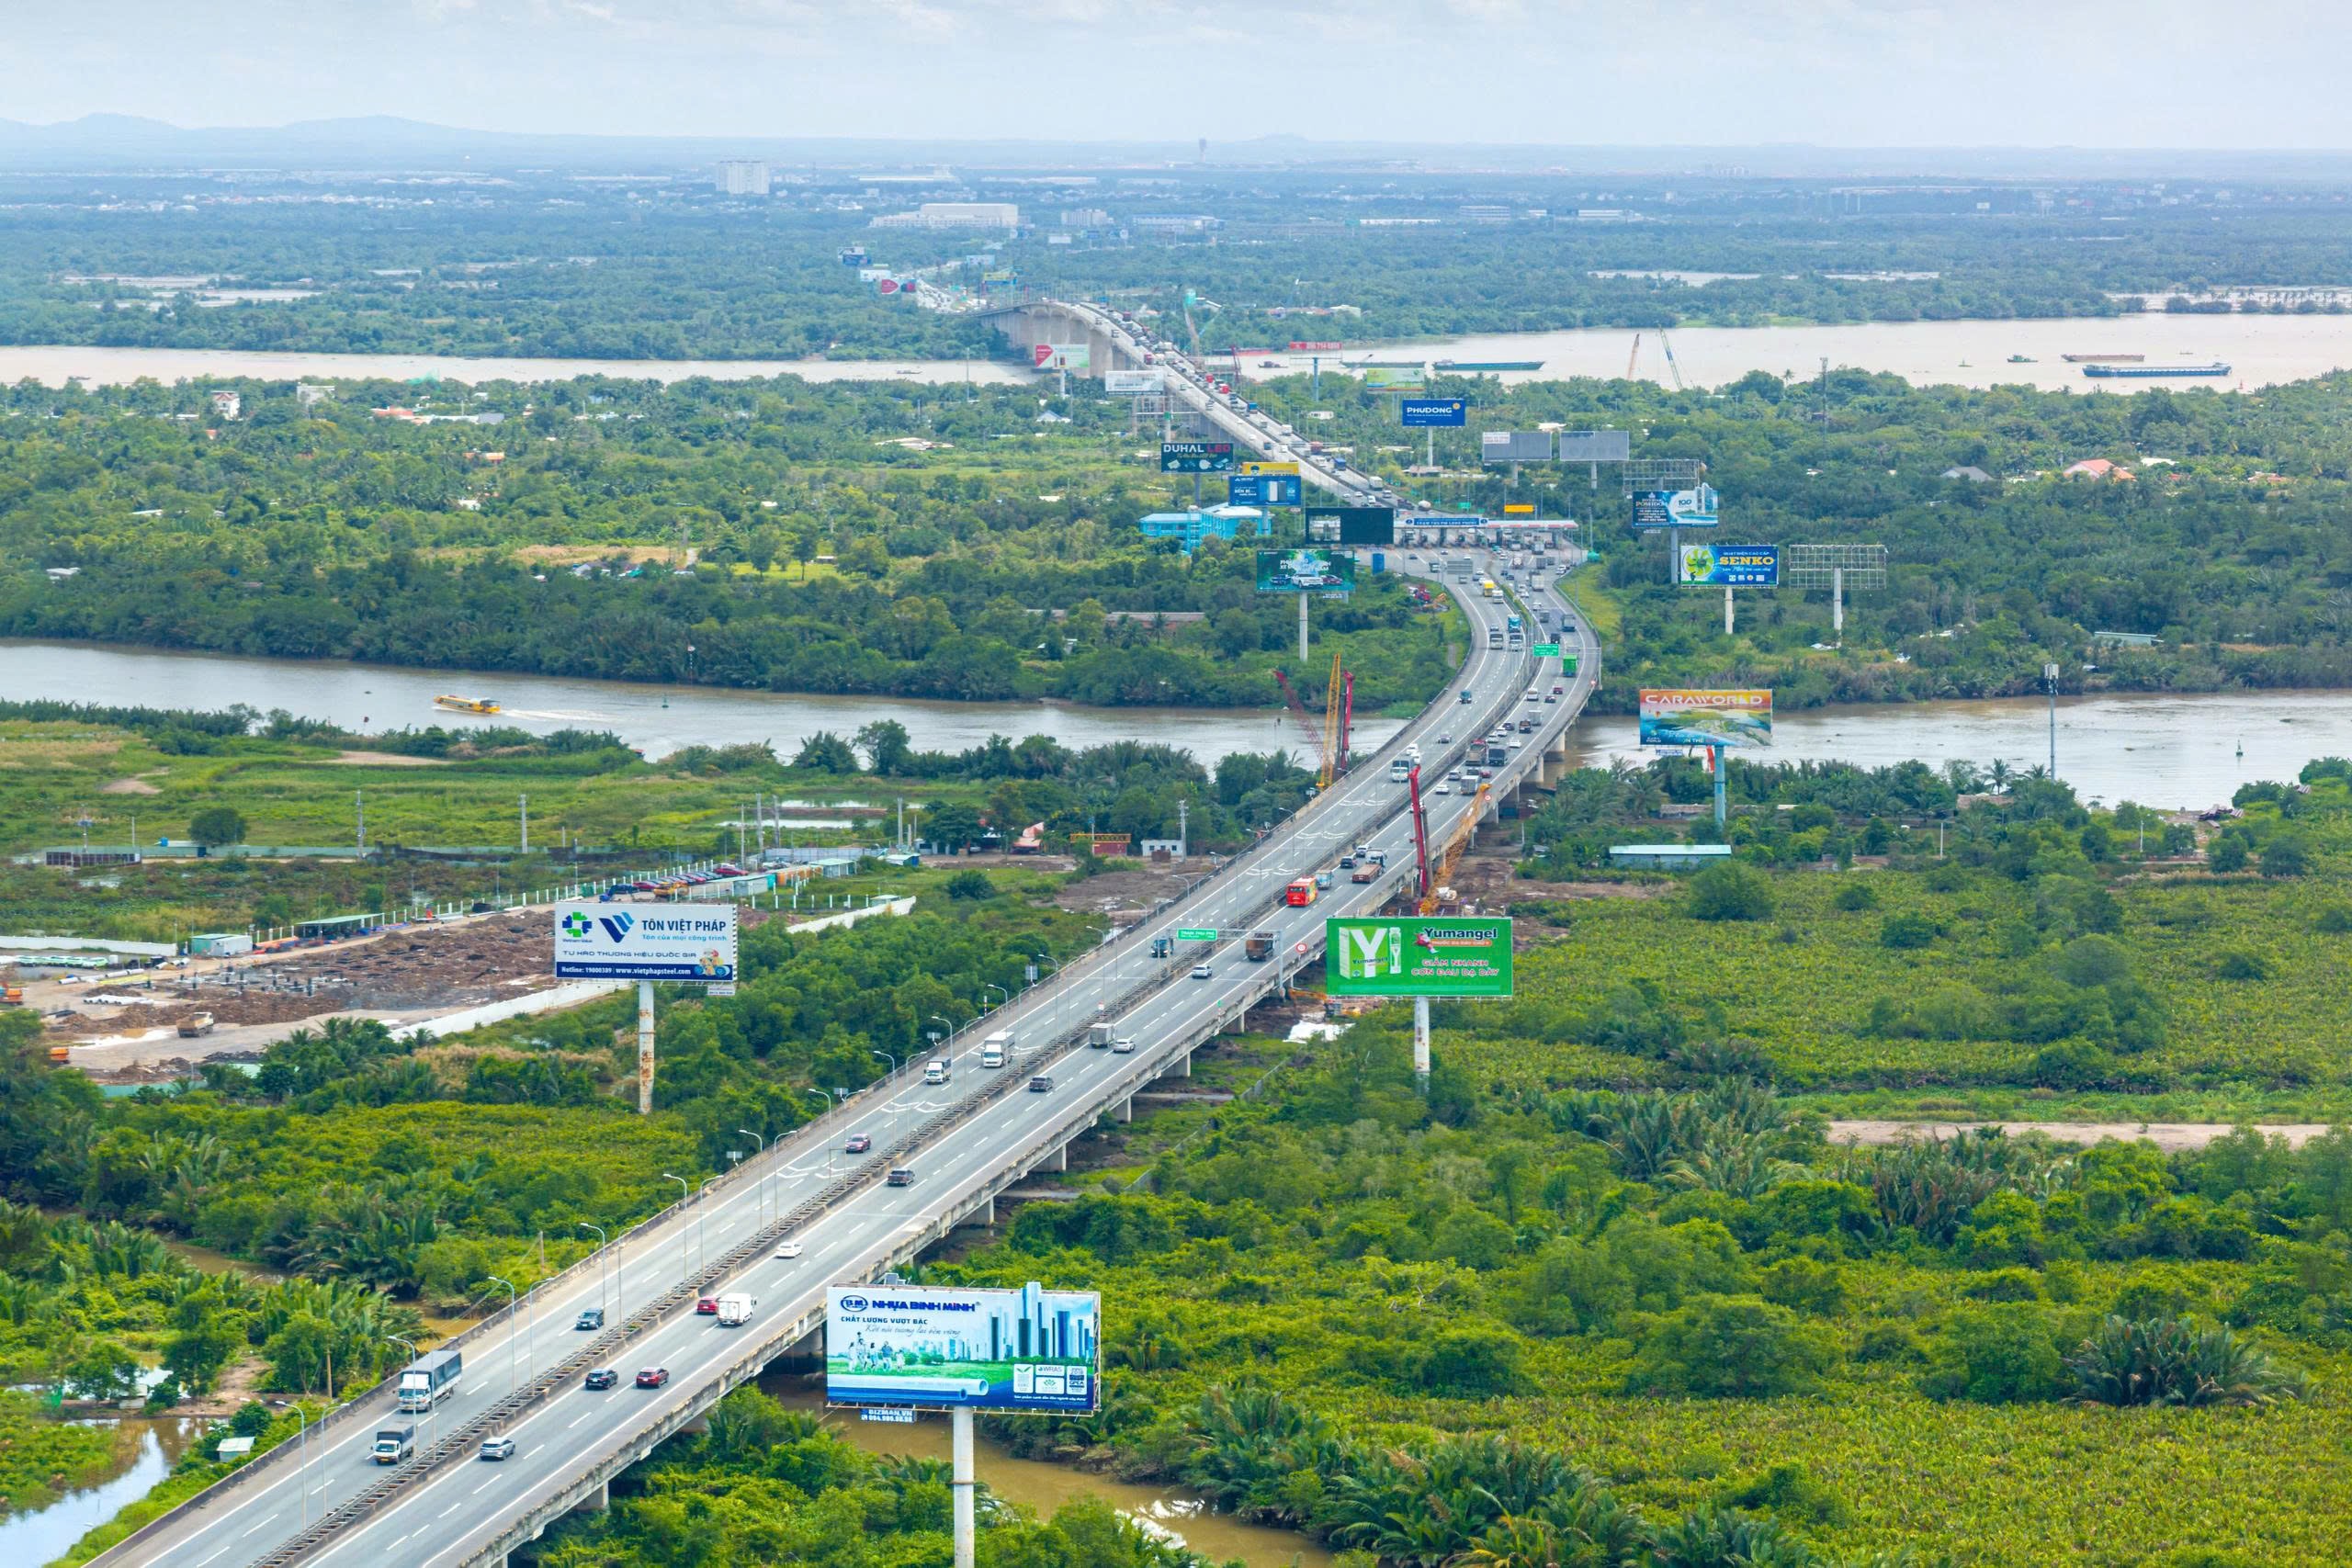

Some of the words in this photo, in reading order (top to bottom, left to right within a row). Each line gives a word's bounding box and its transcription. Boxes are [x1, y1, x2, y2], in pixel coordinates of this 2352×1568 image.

[1163, 445, 1204, 453] DUHAL
[1207, 445, 1231, 453] LED
[1720, 557, 1774, 565] SENKO
[1645, 694, 1763, 705] CARAWORLD
[642, 919, 664, 931] TÔN
[667, 919, 692, 933] VIỆT
[695, 919, 726, 931] PHÁP
[1424, 927, 1498, 941] Yumangel
[1451, 958, 1488, 966] NHANH
[616, 967, 691, 976] www.vietphapsteel.com
[872, 1300, 909, 1312] NHỰA
